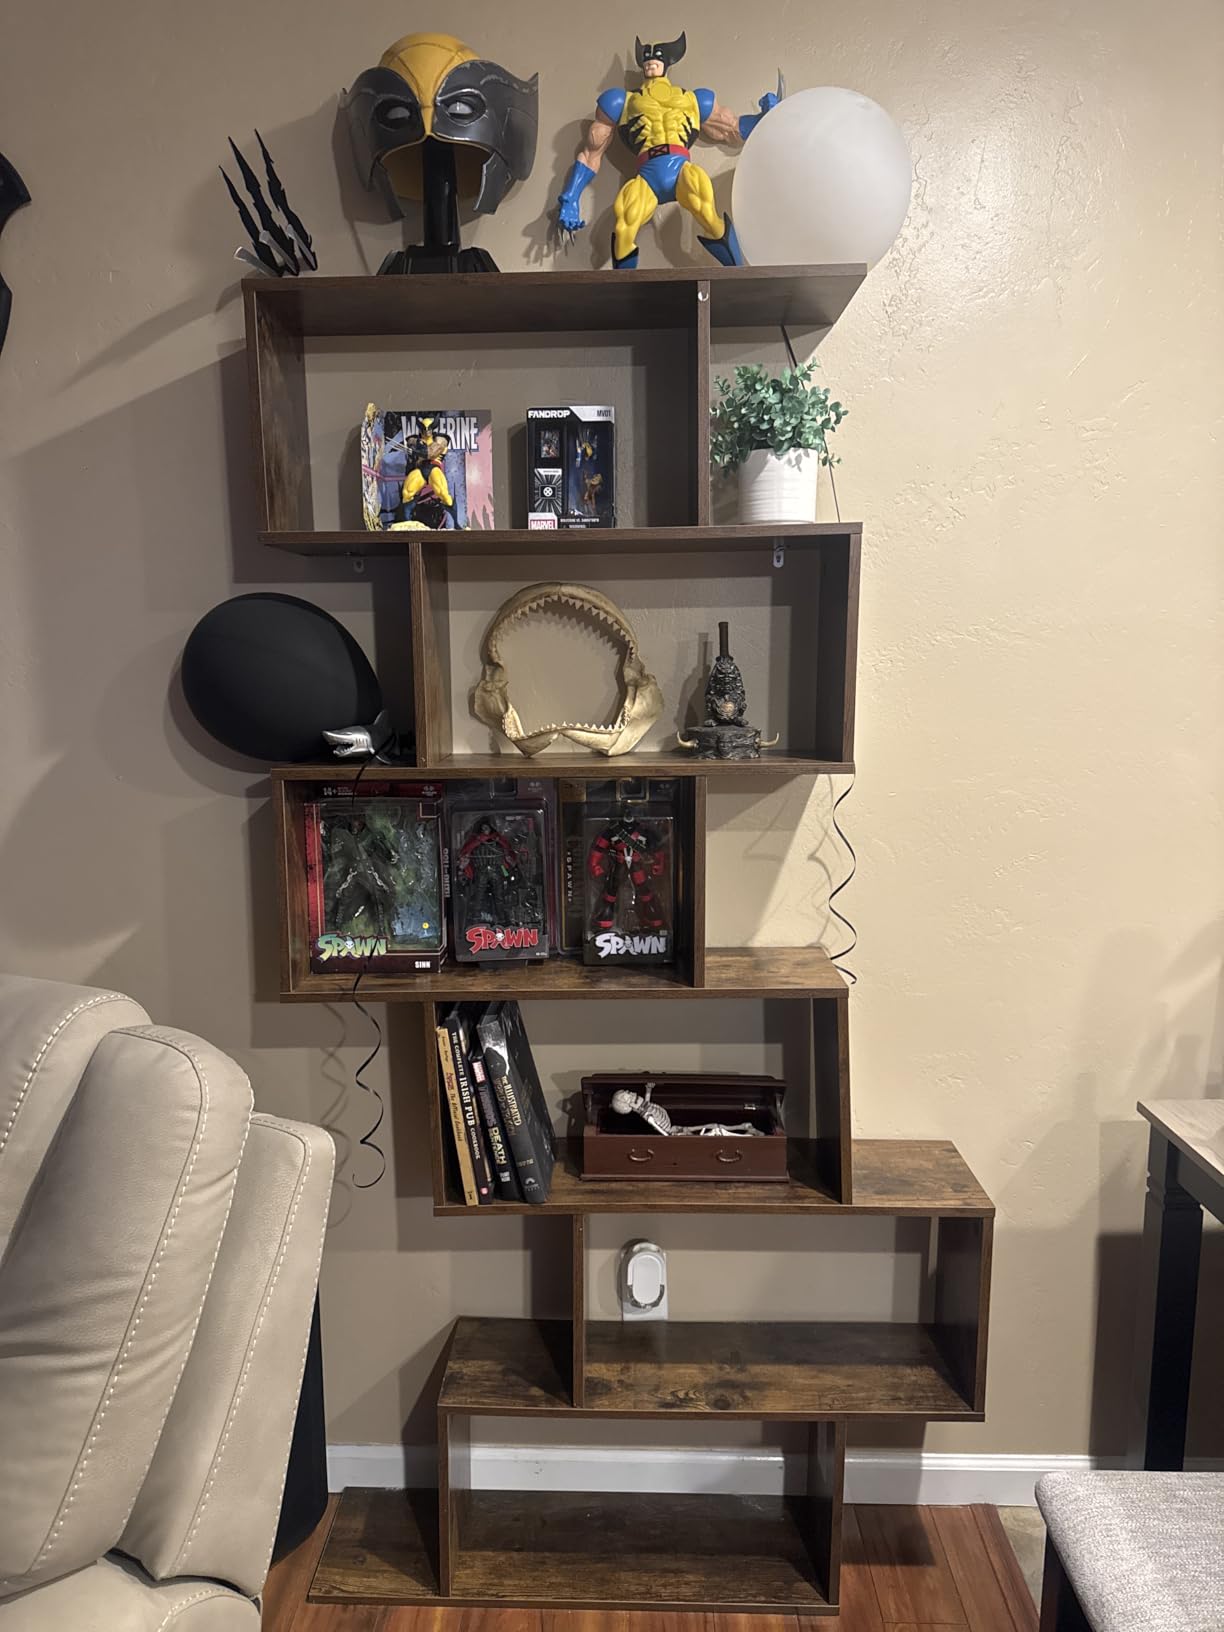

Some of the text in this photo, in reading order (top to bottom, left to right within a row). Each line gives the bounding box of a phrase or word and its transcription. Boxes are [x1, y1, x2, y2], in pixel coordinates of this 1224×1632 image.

[528, 410, 571, 419] FANDROP
[401, 416, 478, 454] WERINE
[530, 520, 554, 530] MARVEL
[317, 933, 387, 961] SPAWN
[466, 926, 539, 954] SPAWN
[595, 932, 667, 959] SPAWN
[454, 1045, 465, 1076] COMPLETE
[459, 1077, 471, 1104] IRISH
[464, 1106, 476, 1126] PUB
[504, 1084, 522, 1126] ILLUSTRATED
[470, 1128, 481, 1160] COOKBOOK
[492, 1126, 507, 1165] DEATH
